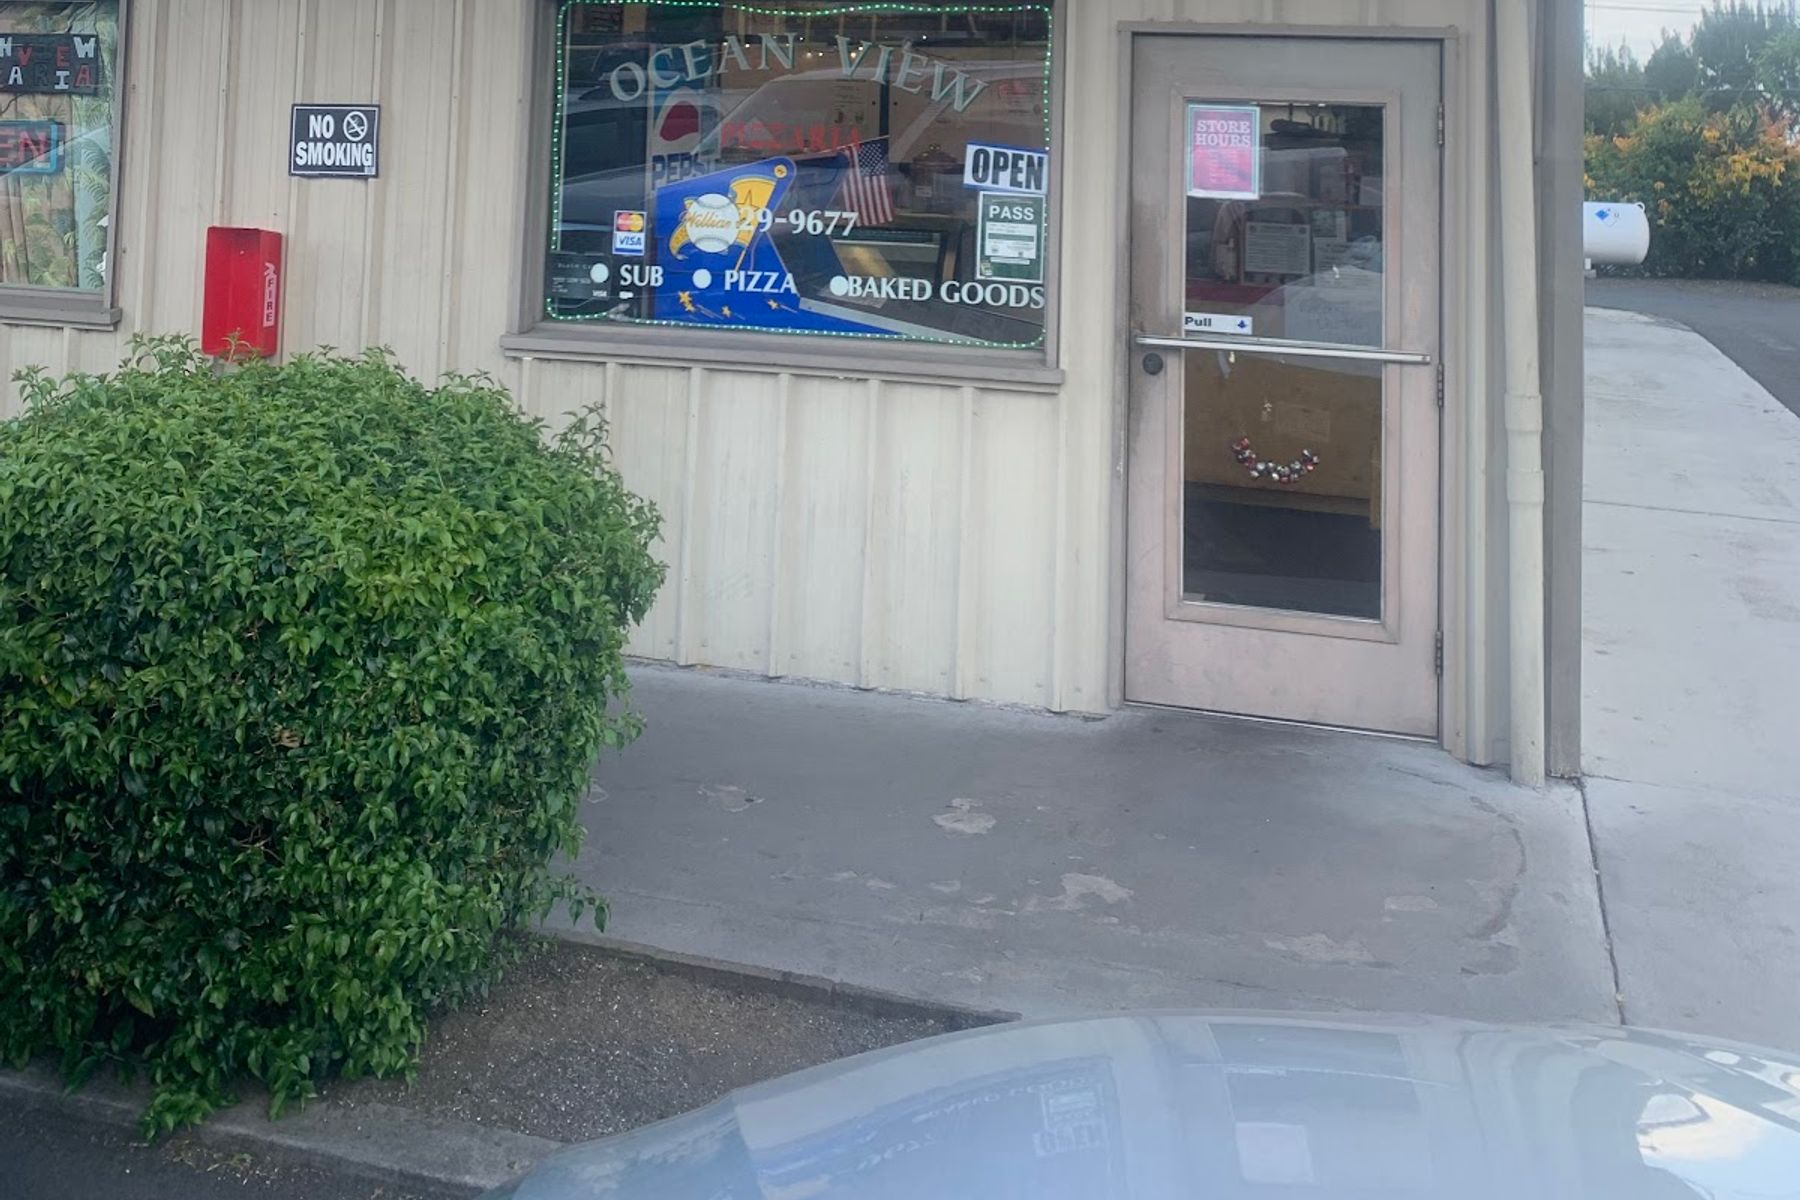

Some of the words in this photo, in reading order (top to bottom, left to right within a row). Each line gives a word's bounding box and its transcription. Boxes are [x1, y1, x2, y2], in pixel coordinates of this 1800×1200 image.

[0, 65, 92, 90] ARIA
[610, 32, 797, 101] OCEAN
[835, 35, 988, 112] VIEW
[309, 114, 335, 139] NO
[1197, 120, 1250, 133] STORE
[1195, 133, 1251, 148] HOURS
[295, 141, 373, 166] SMOKING
[972, 148, 1044, 191] OPEN
[738, 208, 858, 237] 29-9677
[989, 205, 1034, 220] PASS
[619, 236, 642, 246] VISA
[266, 277, 274, 321] FIRE
[619, 264, 664, 287] SUB
[724, 269, 798, 294] PIZZA
[848, 276, 932, 301] BAKED
[940, 280, 1045, 309] GOODS
[1184, 316, 1212, 327] Pull
